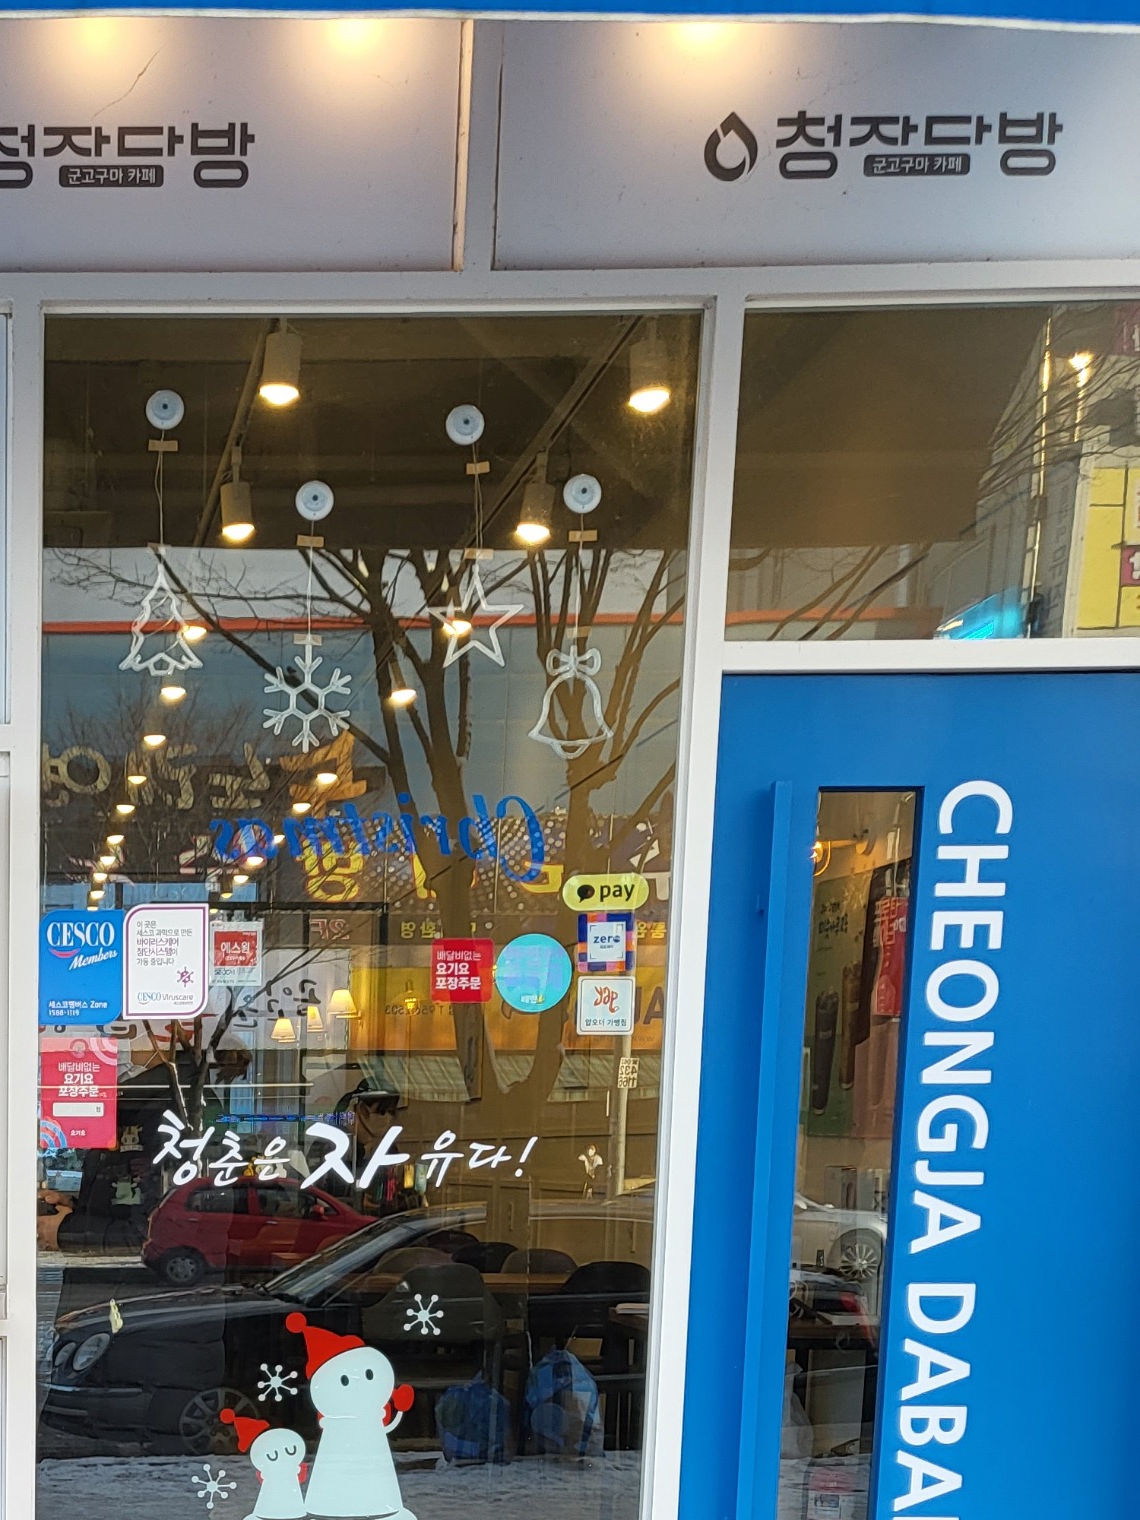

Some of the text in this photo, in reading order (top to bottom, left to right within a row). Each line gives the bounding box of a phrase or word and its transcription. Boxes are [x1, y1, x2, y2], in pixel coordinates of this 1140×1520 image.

[775, 110, 1063, 180] 청자다방
[871, 157, 962, 174] 군고구마 카페
[67, 168, 156, 184] 군고구마 카페
[599, 883, 635, 902] pay
[47, 921, 115, 948] CESCO
[593, 934, 620, 944] zero
[220, 941, 250, 954] 에스원
[68, 946, 118, 970] Members
[436, 950, 481, 960] 배달비없는
[436, 963, 469, 975] 요기요
[435, 977, 481, 990] 포장주문
[137, 992, 161, 1002] CESCO
[90, 1000, 107, 1009] Zone
[909, 780, 1013, 1255] CHEONGJA
[58, 1062, 101, 1073] 배달비없는
[63, 1073, 93, 1084] 요기요
[58, 1084, 99, 1098] 포장주문
